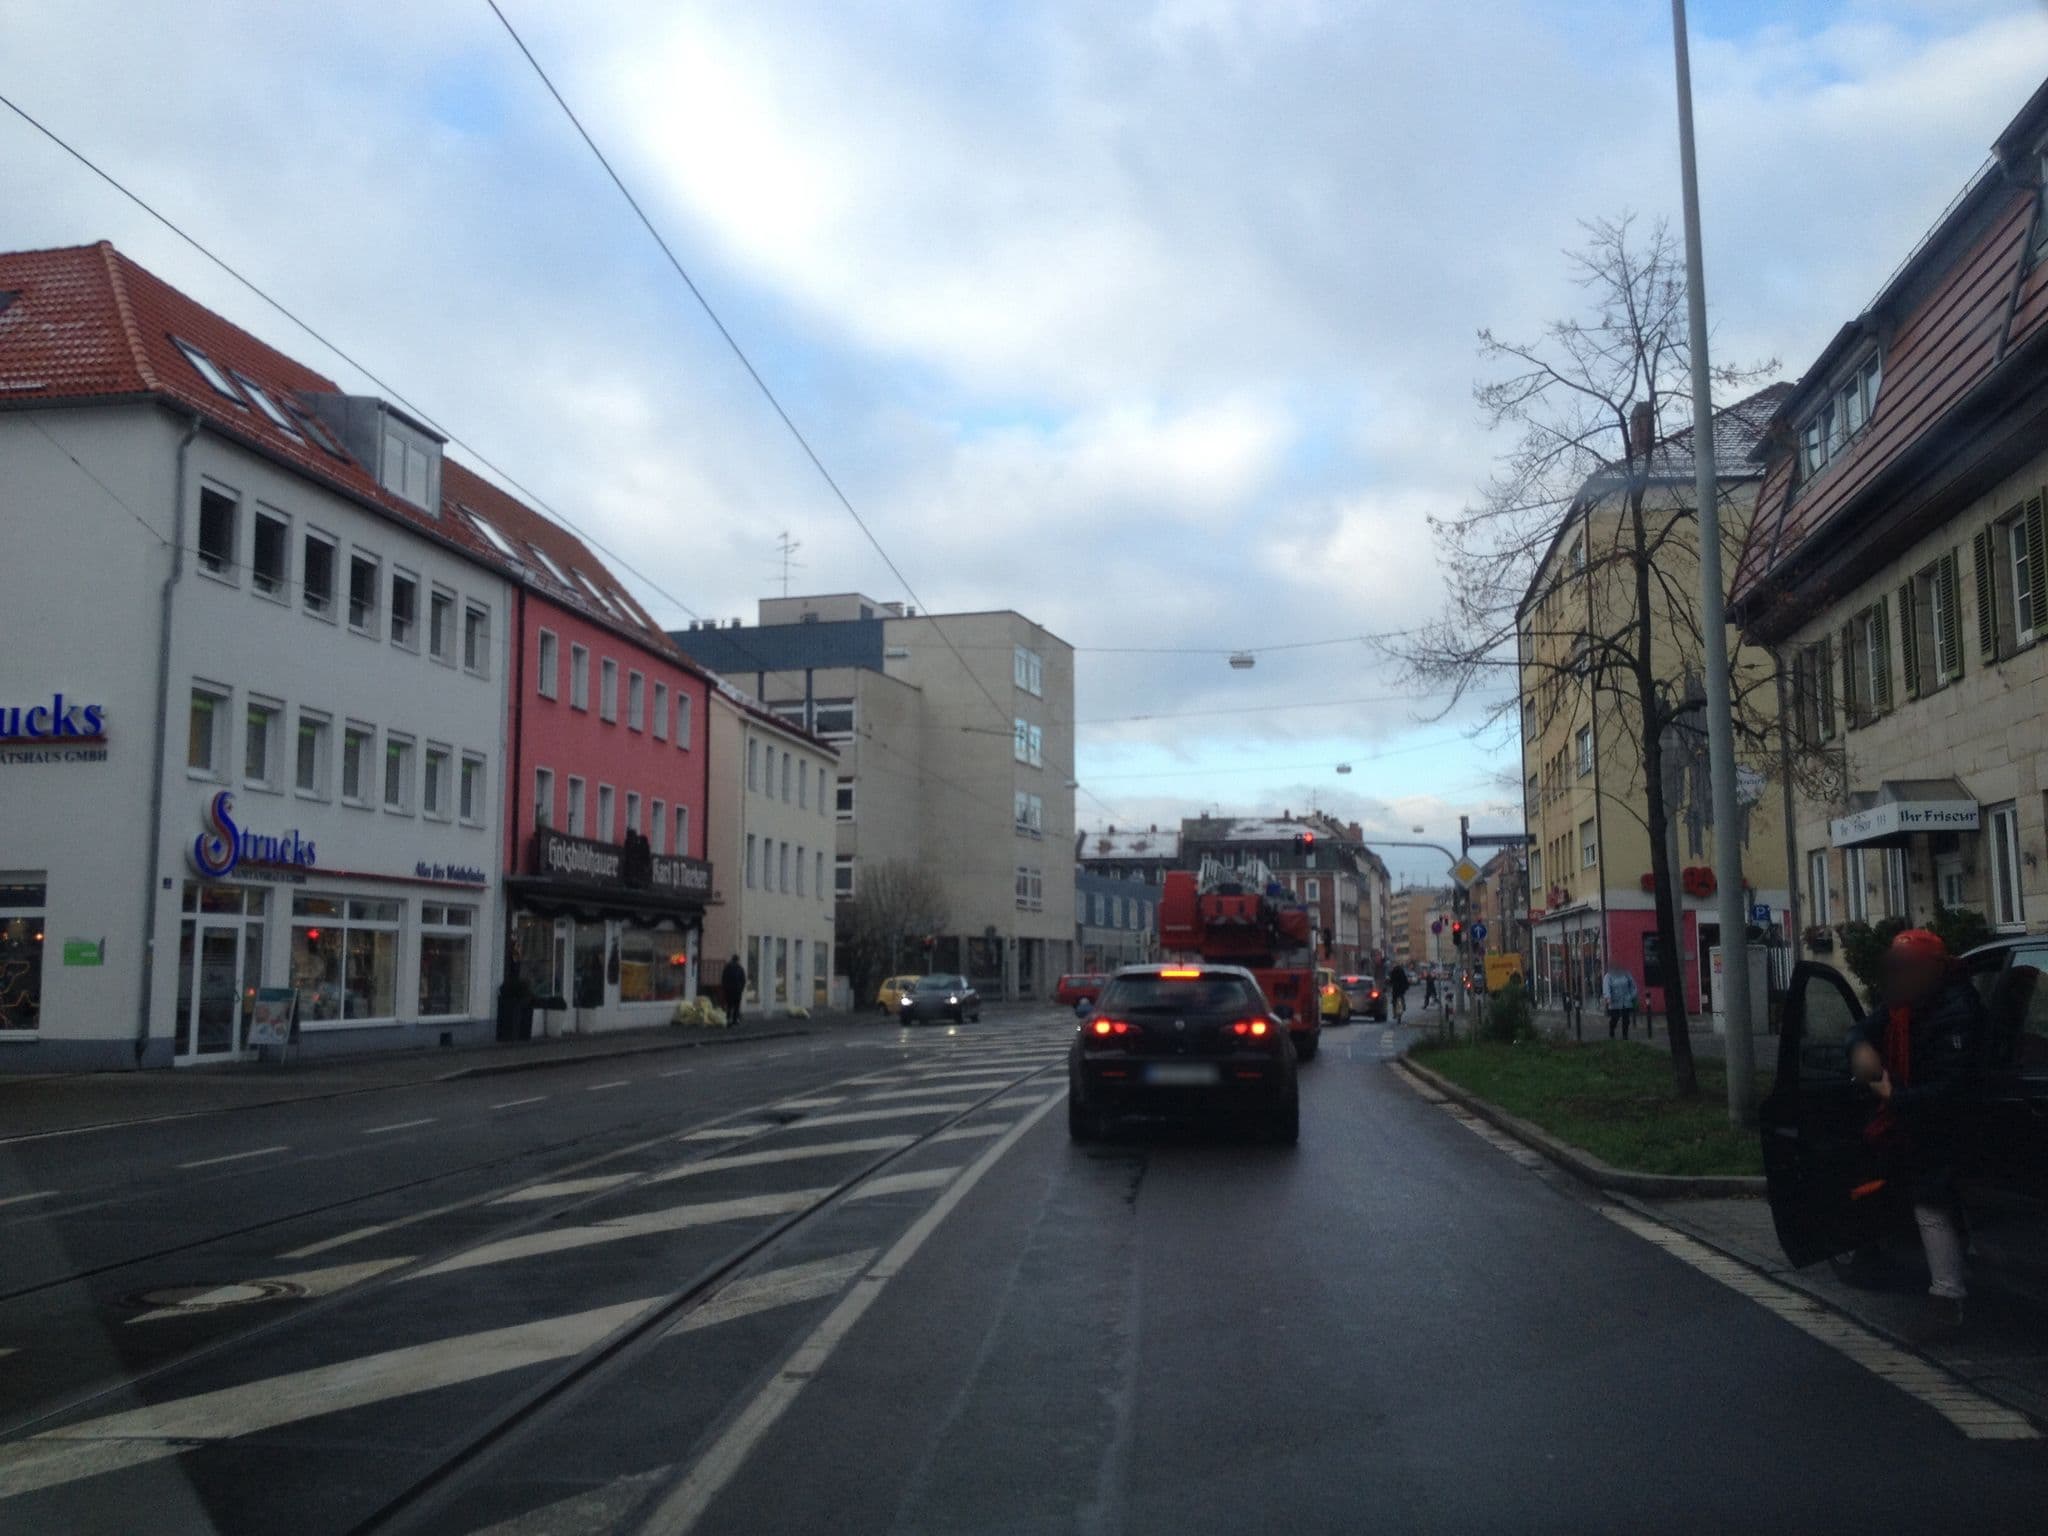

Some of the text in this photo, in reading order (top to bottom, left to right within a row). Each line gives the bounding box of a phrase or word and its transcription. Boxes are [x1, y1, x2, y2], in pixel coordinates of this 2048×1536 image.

[195, 790, 316, 877] Strucks
[1900, 810, 1977, 823] Ihr Friseur
